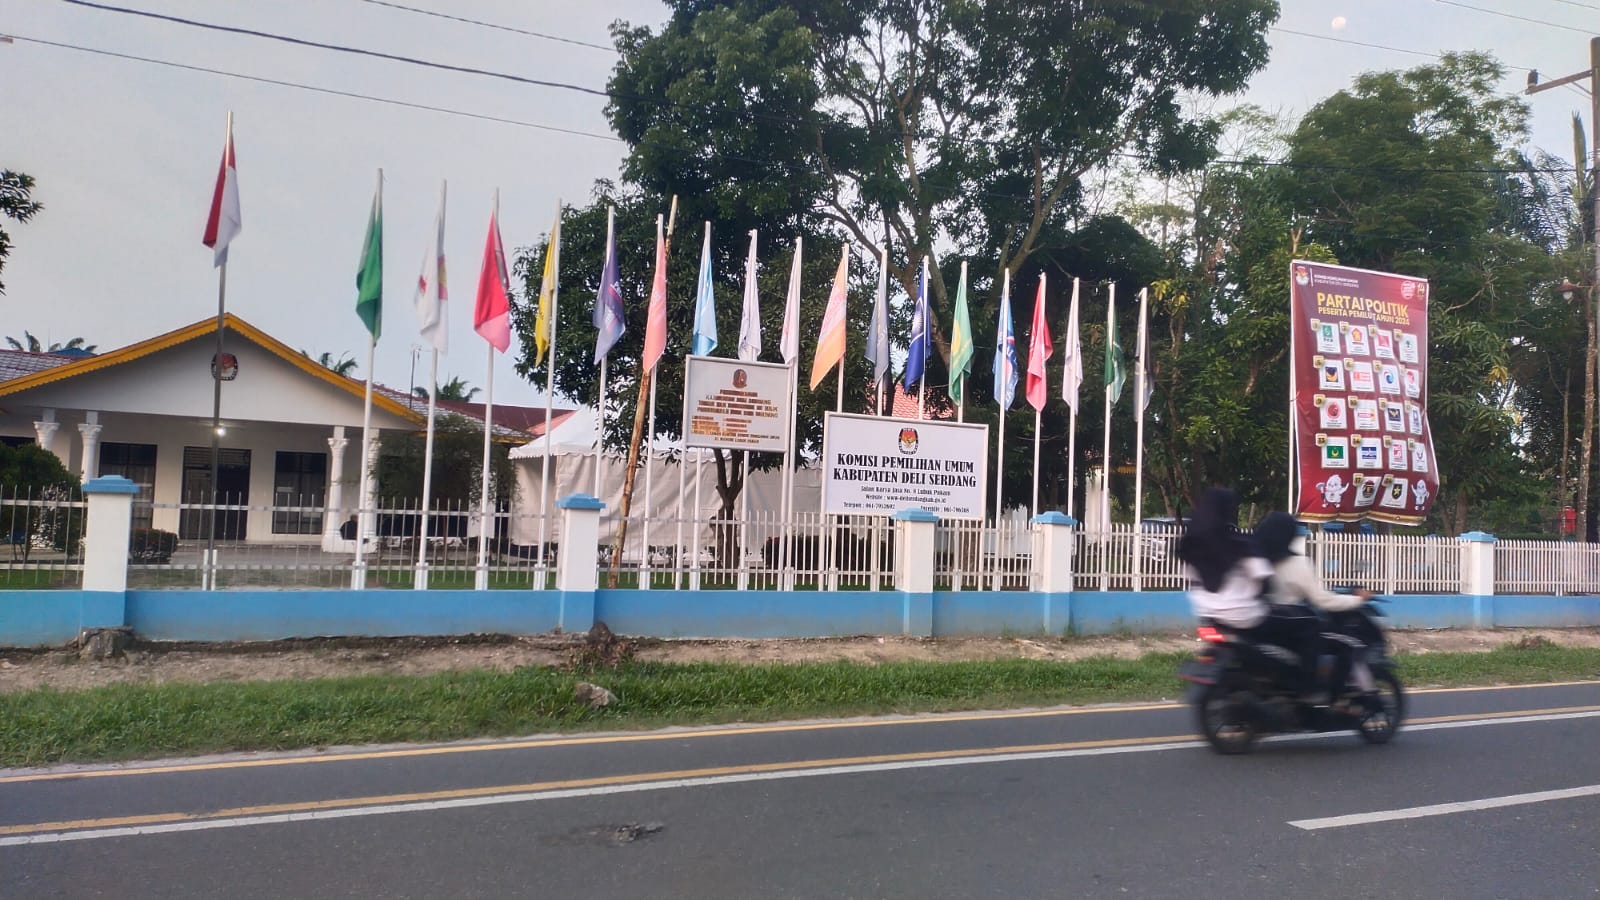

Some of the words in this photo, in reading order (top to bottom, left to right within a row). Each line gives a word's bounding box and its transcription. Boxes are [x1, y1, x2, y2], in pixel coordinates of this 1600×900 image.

[1317, 292, 1364, 310] PARTAI
[1365, 298, 1409, 318] POLITIK
[1318, 306, 1347, 317] PESERTA
[1348, 310, 1373, 319] PEMILU
[837, 453, 878, 468] KOMISI
[881, 456, 942, 471] PEMILIHAN
[944, 460, 974, 473] UMUM
[833, 468, 898, 483] KABUPATEN
[901, 472, 926, 485] DELI
[928, 474, 977, 488] SERDANG
